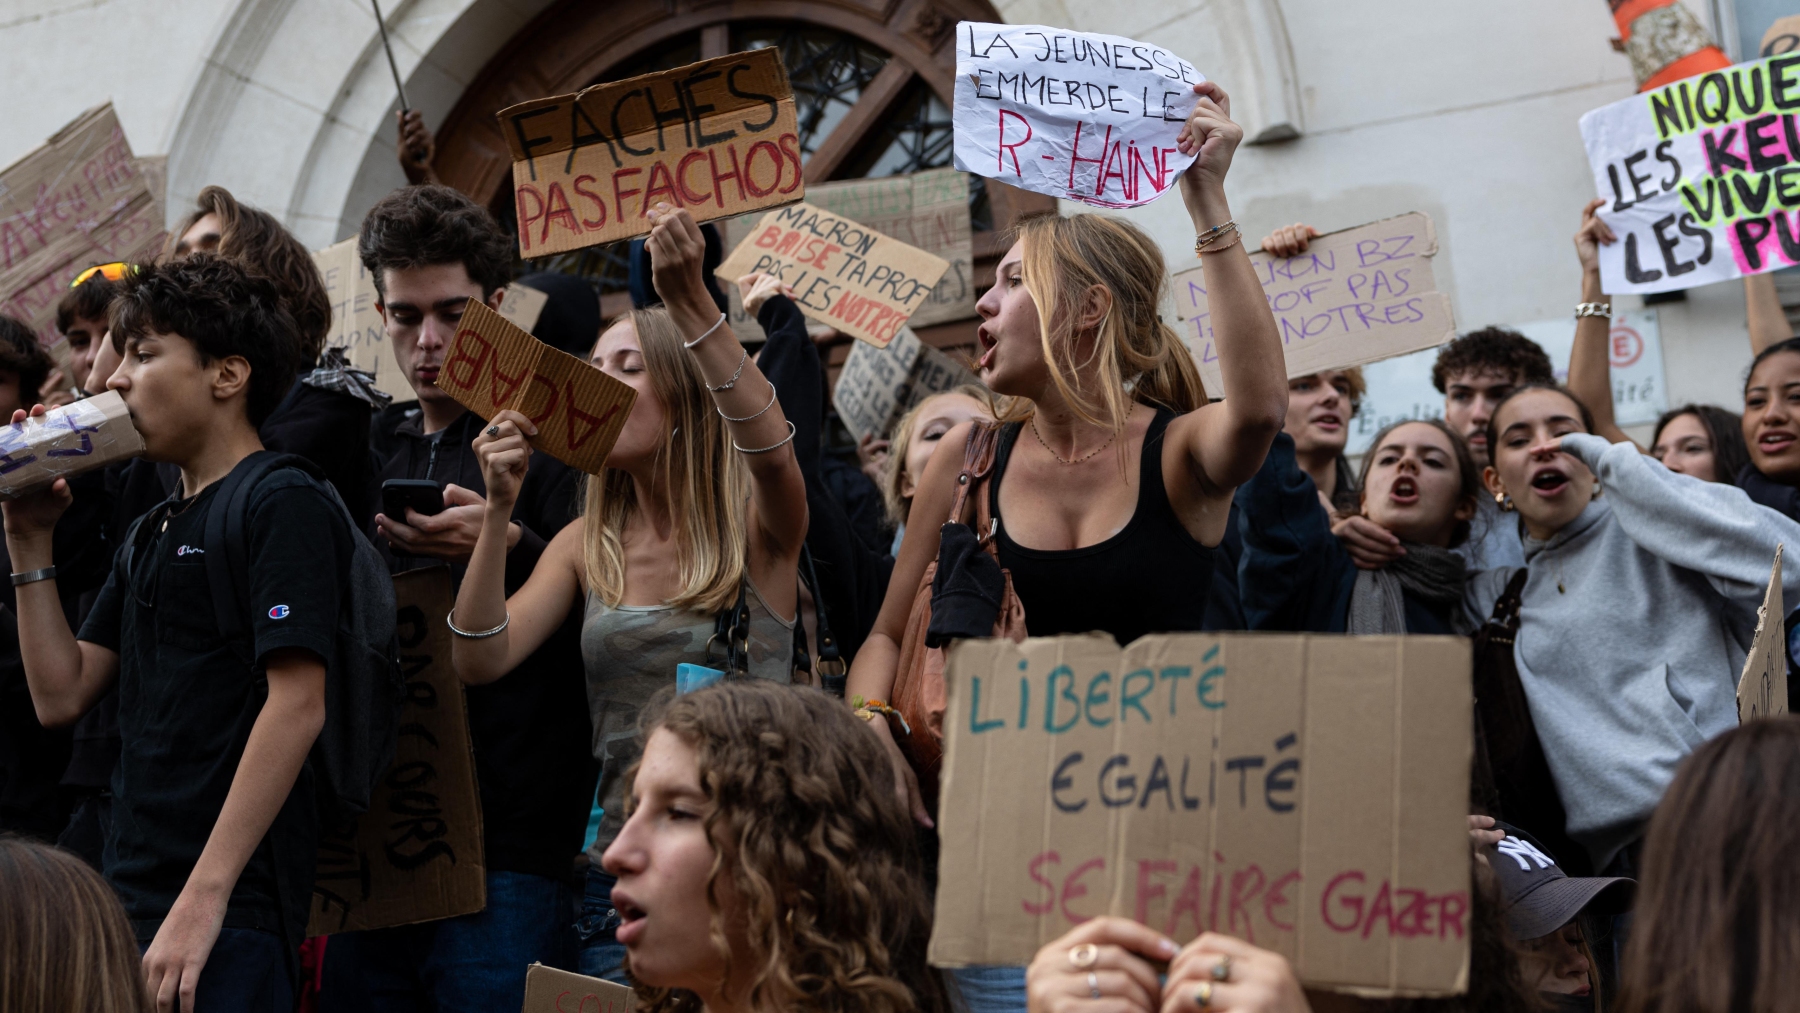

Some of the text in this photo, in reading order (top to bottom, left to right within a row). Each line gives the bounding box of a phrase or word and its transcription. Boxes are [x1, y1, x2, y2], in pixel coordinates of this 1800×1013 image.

[969, 25, 1196, 86] LA JEUNESSE
[511, 63, 779, 182] FACHÉS
[977, 68, 1187, 122] EMMERDE LE
[1650, 56, 1800, 139] NIQUE
[517, 132, 803, 251] PAS FACHOS
[1607, 140, 1682, 213] LES
[1682, 167, 1800, 223] VIVE
[776, 207, 877, 256] MACRON
[1356, 235, 1415, 268] BZ
[1624, 213, 1713, 285] LES
[1347, 268, 1412, 300] PAS
[828, 289, 909, 343] NOTRES
[1281, 297, 1425, 345] NOTRES
[446, 328, 621, 451] ACAB
[1022, 850, 1107, 925] SE
[1321, 870, 1470, 940] GAZER
